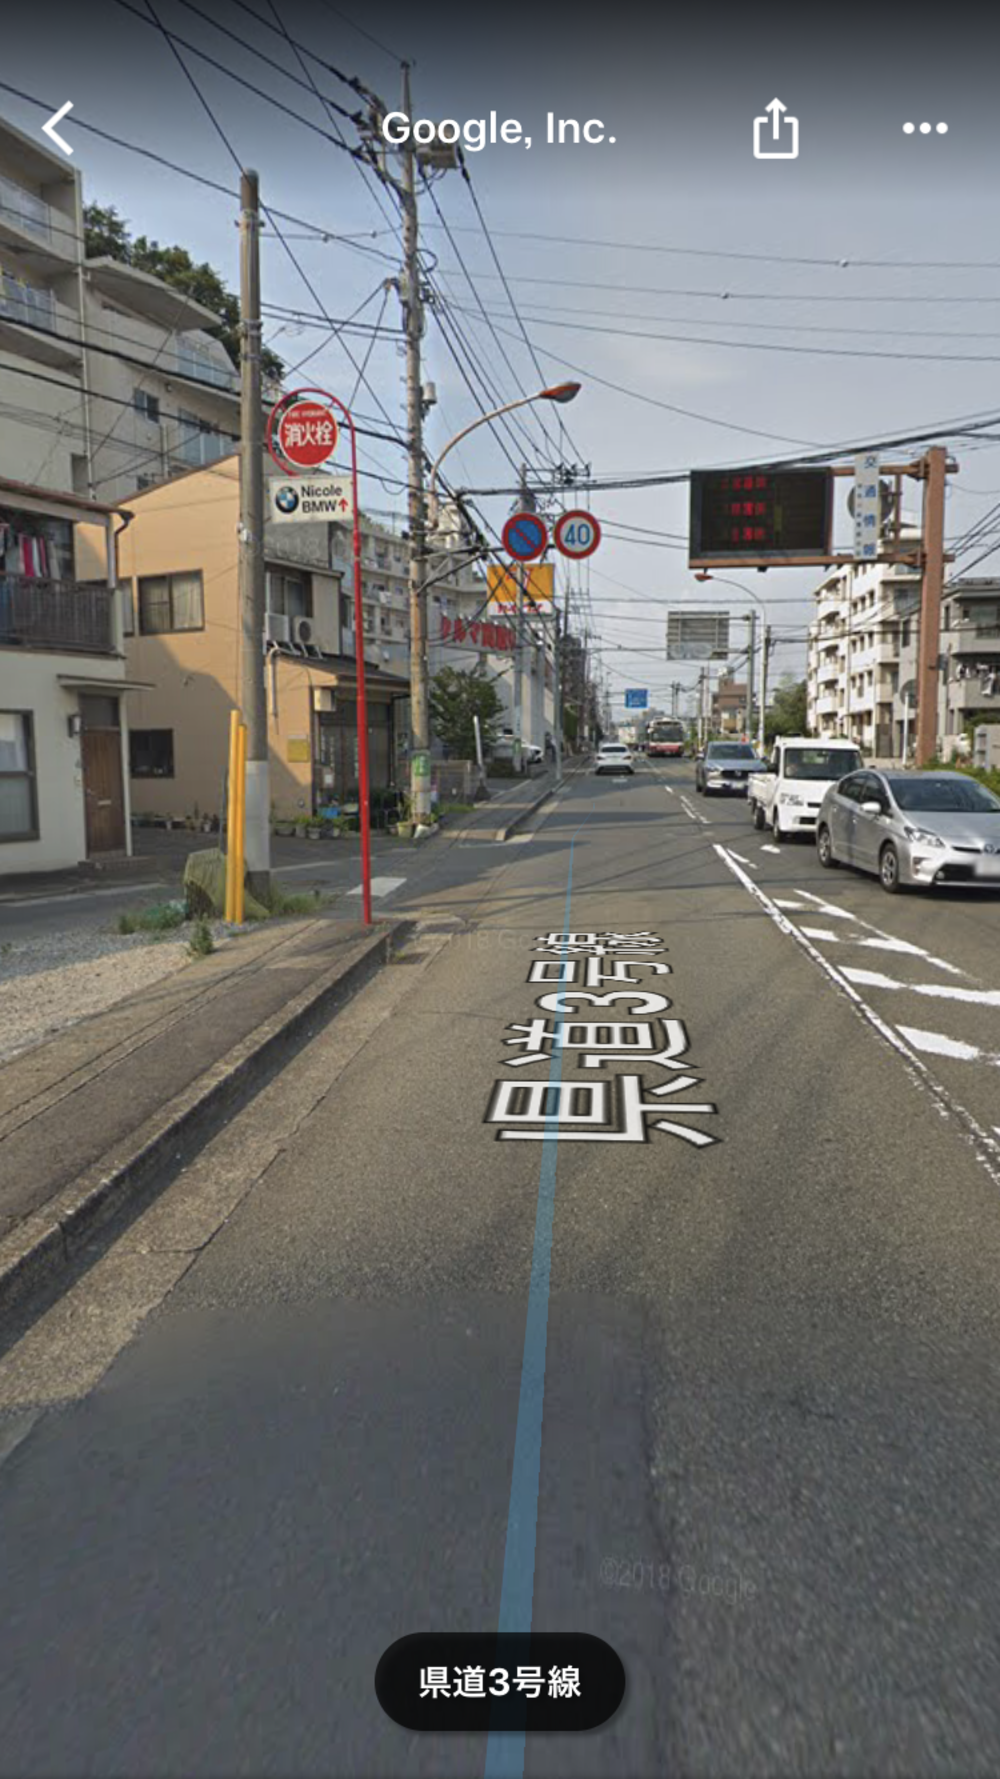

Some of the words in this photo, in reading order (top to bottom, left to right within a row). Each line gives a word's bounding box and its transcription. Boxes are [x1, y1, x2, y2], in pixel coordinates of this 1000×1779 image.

[285, 420, 333, 447] 消火栓
[301, 485, 342, 498] Nicole
[302, 500, 337, 513] BMW
[564, 523, 590, 546] 40
